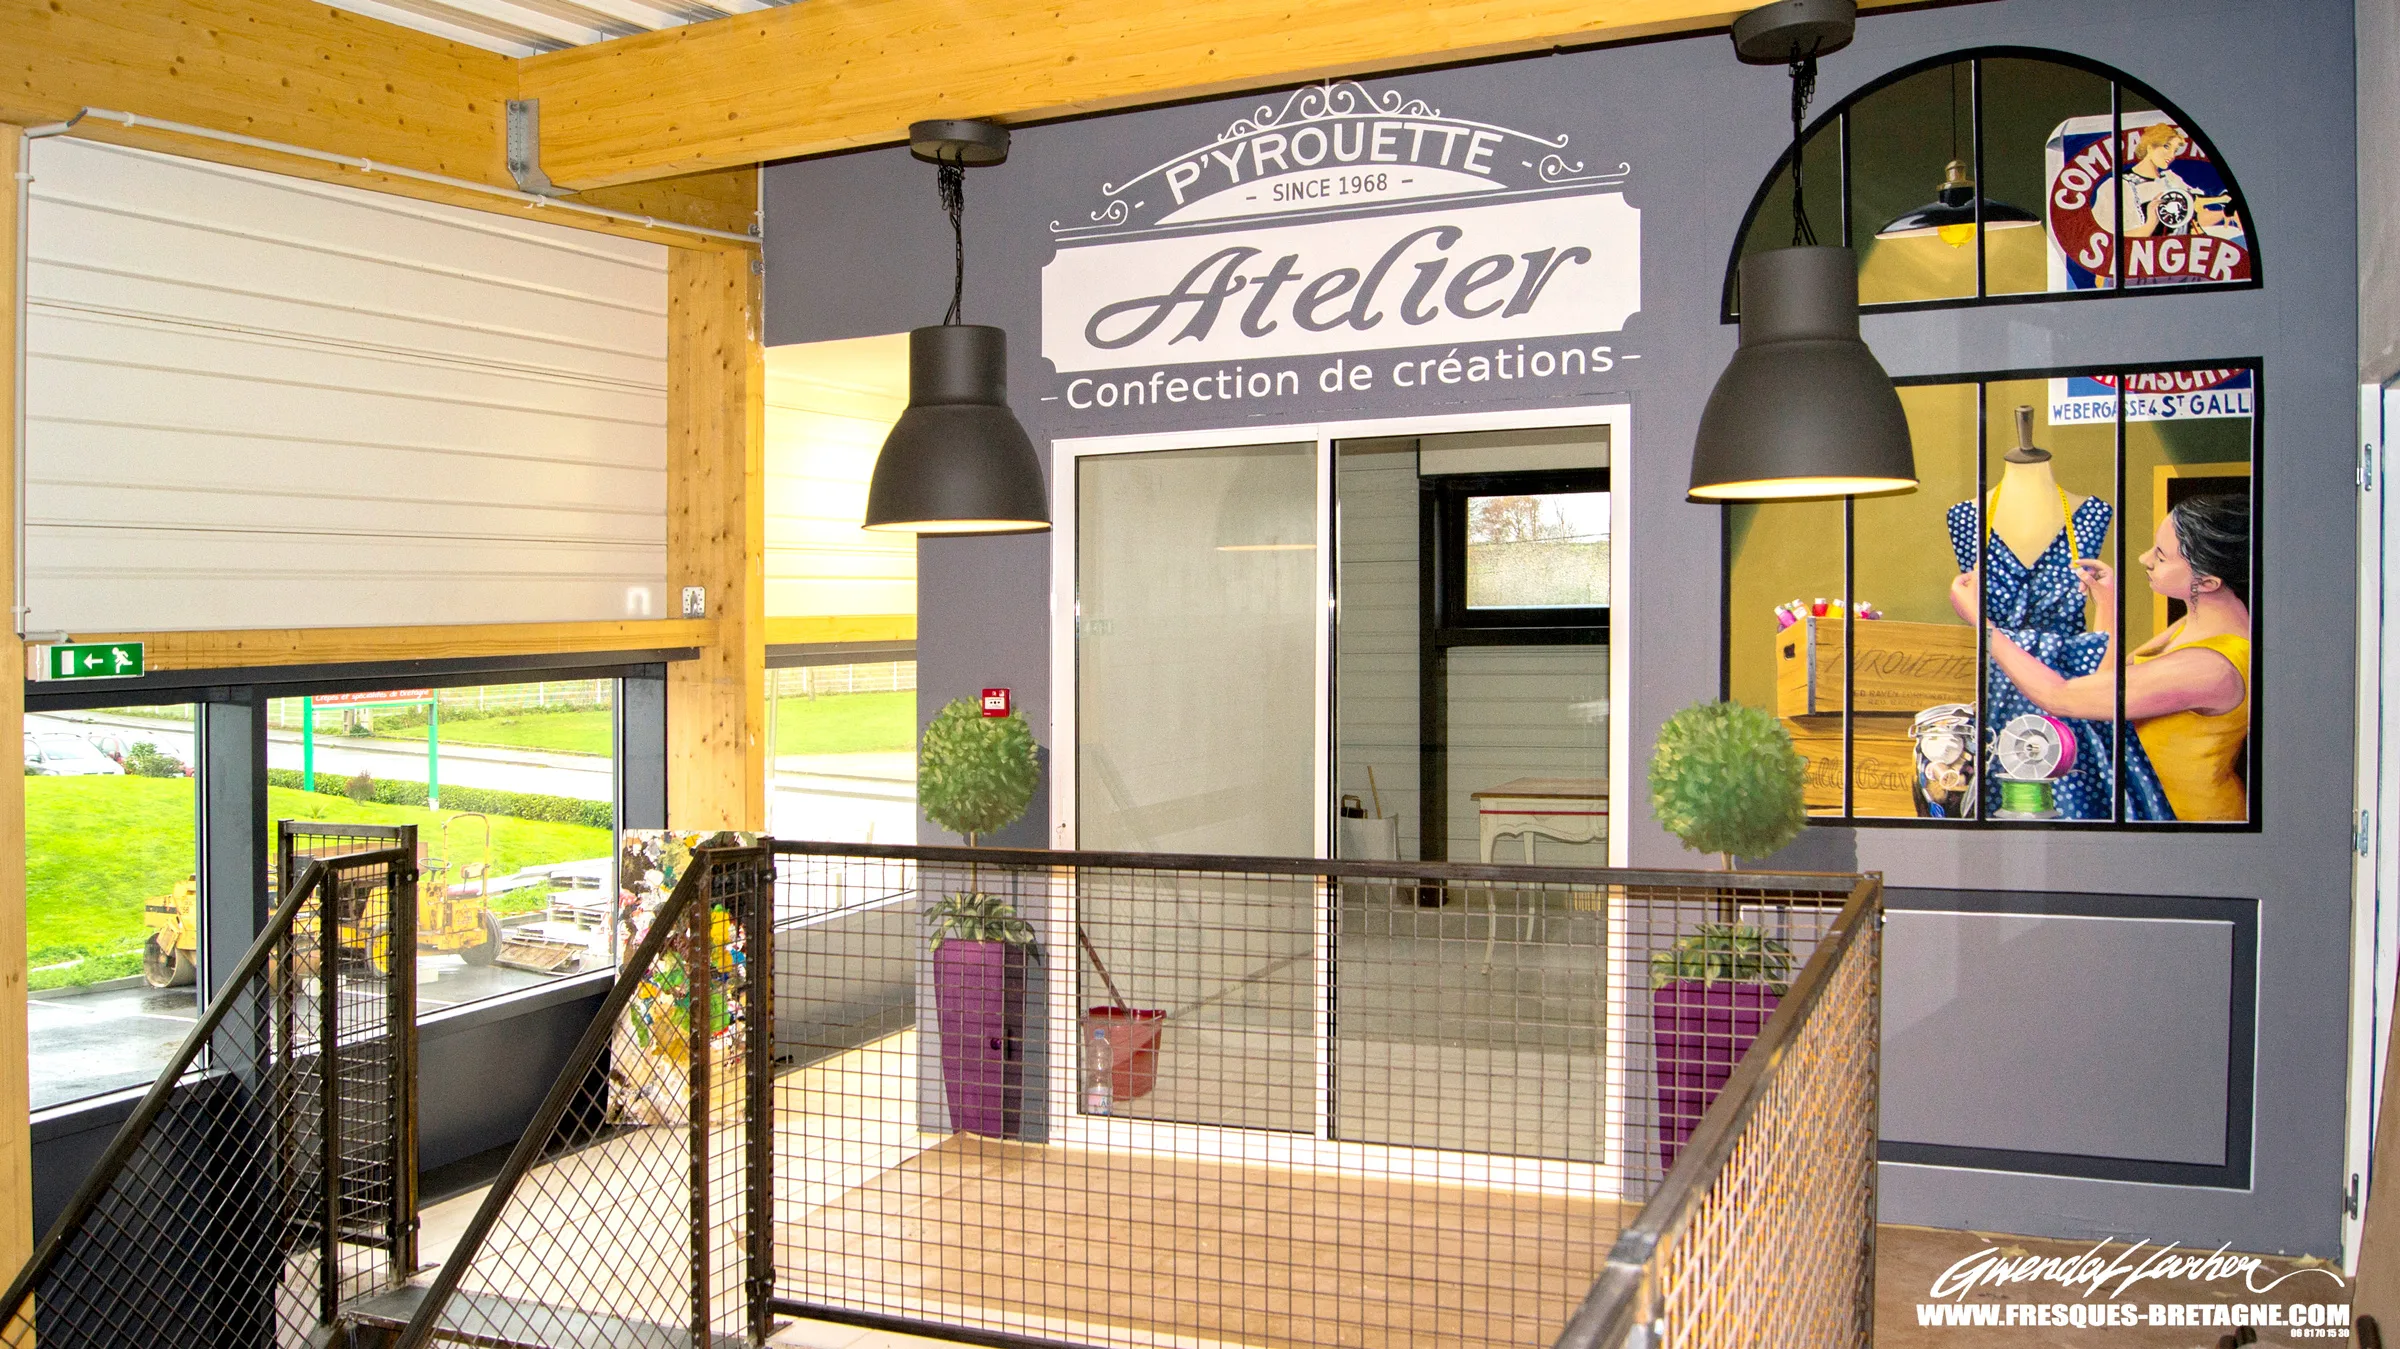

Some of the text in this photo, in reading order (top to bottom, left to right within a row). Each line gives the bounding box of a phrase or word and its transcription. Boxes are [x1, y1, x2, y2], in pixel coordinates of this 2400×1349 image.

[1272, 173, 1388, 201] SINCE 1968
[1084, 225, 1592, 349] Atelier
[1065, 345, 1614, 409] Confection de créations
